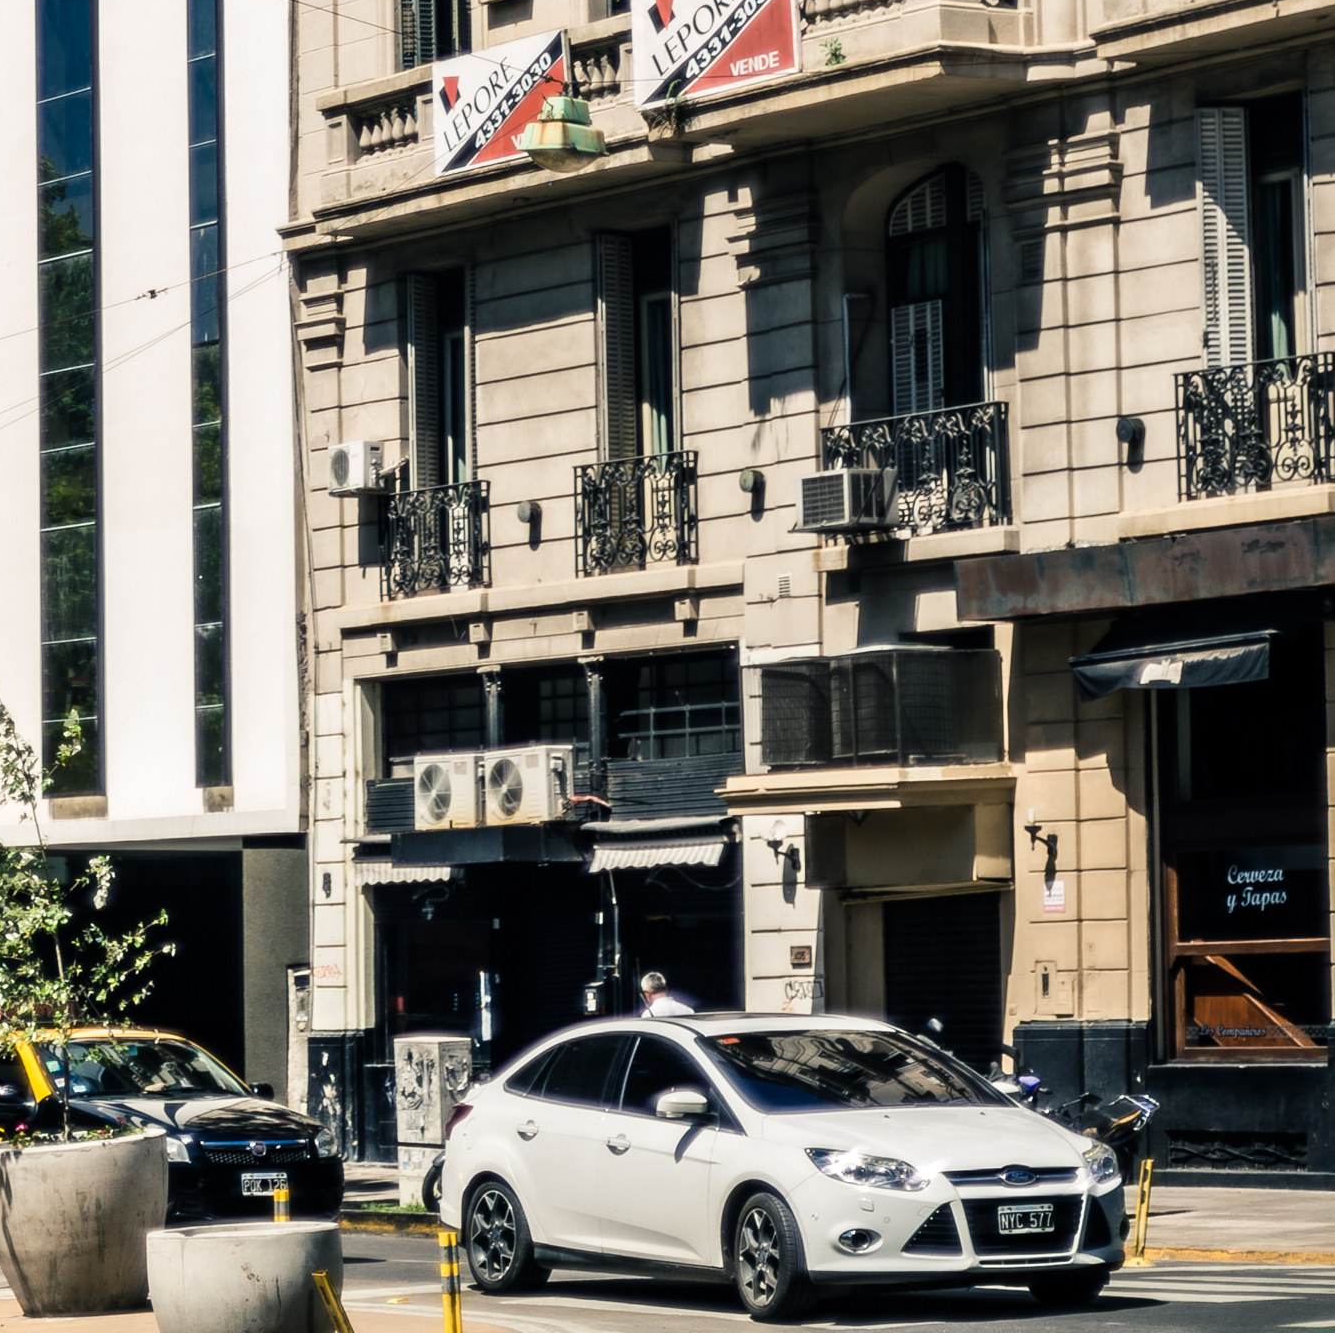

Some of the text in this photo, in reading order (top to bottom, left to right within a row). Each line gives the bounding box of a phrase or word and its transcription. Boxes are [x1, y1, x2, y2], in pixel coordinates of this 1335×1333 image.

[730, 50, 780, 76] VENDE
[443, 56, 514, 152] LEPORE
[474, 51, 553, 149] 4331-3030
[1227, 864, 1285, 885] Cerveza
[1227, 886, 1287, 914] y Tapas
[1001, 1212, 1052, 1229] NYC 577
